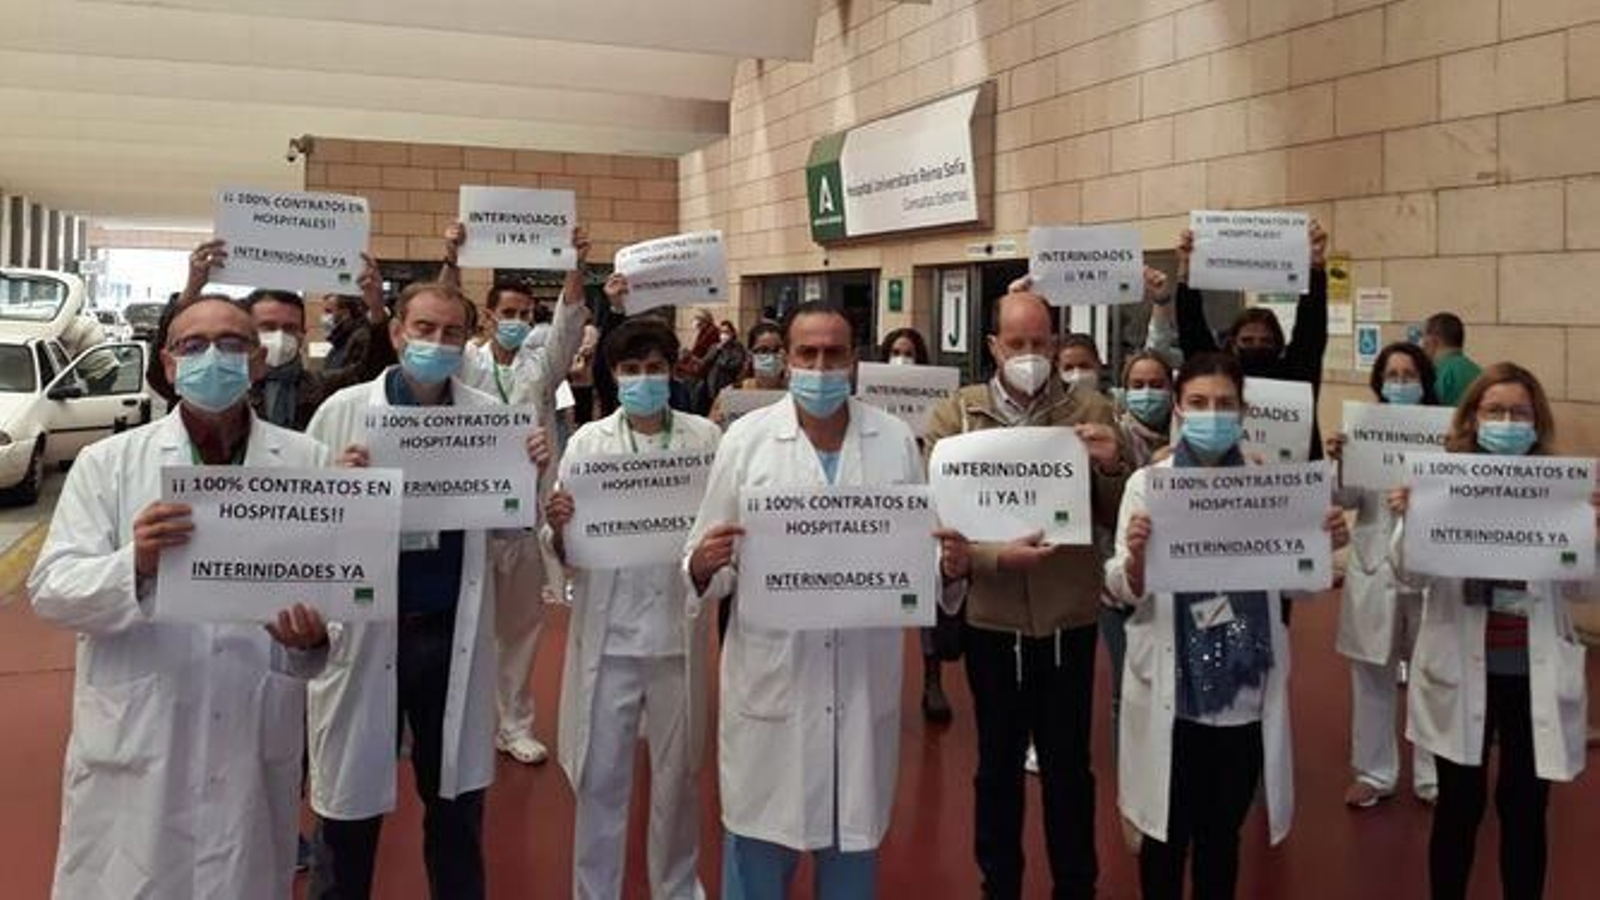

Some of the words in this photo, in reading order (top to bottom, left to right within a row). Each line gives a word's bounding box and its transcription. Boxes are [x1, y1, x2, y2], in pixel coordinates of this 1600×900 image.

[274, 197, 346, 213] CONTRATOS
[253, 213, 336, 230] HOSPITALES!!
[469, 212, 567, 226] INTERINIDADES
[509, 233, 527, 244] YA
[233, 246, 326, 267] INTERINIDADES
[1038, 250, 1133, 262] INTERINIDADES
[1078, 270, 1095, 281] YA
[382, 415, 419, 428] 100%
[424, 413, 510, 428] CONTRATOS
[514, 412, 531, 426] EN
[401, 435, 497, 449] HOSPITALES!!
[584, 462, 619, 475] 100%
[622, 456, 702, 473] CONTRATOS
[942, 462, 1073, 478] INTERINIDADES
[1429, 462, 1467, 476] 100%
[1471, 464, 1563, 479] CONTRATOS
[1567, 466, 1588, 479] EN
[193, 477, 244, 493] 100%
[248, 476, 363, 496] CONTRATOS
[367, 480, 392, 496] EN
[404, 480, 489, 493] ERINIDADES
[492, 478, 512, 491] YA
[602, 475, 691, 491] HOSPITALES!!
[1170, 477, 1208, 490] 100%
[1212, 474, 1300, 490] CONTRATOS
[1305, 471, 1323, 485] EN
[996, 490, 1019, 505] YA
[1451, 485, 1550, 499] HOSPITALES!!
[765, 496, 805, 511] 100%
[809, 495, 905, 510] CONTRATOS
[907, 496, 928, 509] EN
[1189, 496, 1289, 511] HOSPITALES!!
[219, 503, 345, 523] HOSPITALES!!
[586, 517, 684, 535] INTERINIDADES
[786, 519, 891, 535] HOSPITALES!!
[1431, 528, 1544, 544] INTERINIDADES
[1547, 532, 1569, 545] YA
[1170, 539, 1281, 556] INTERINIDADES
[1285, 538, 1304, 552] YA
[191, 562, 336, 580] INTERINIDADES
[341, 564, 365, 580] YA
[766, 572, 885, 588] INTERINIDADES
[888, 572, 910, 586] YA
